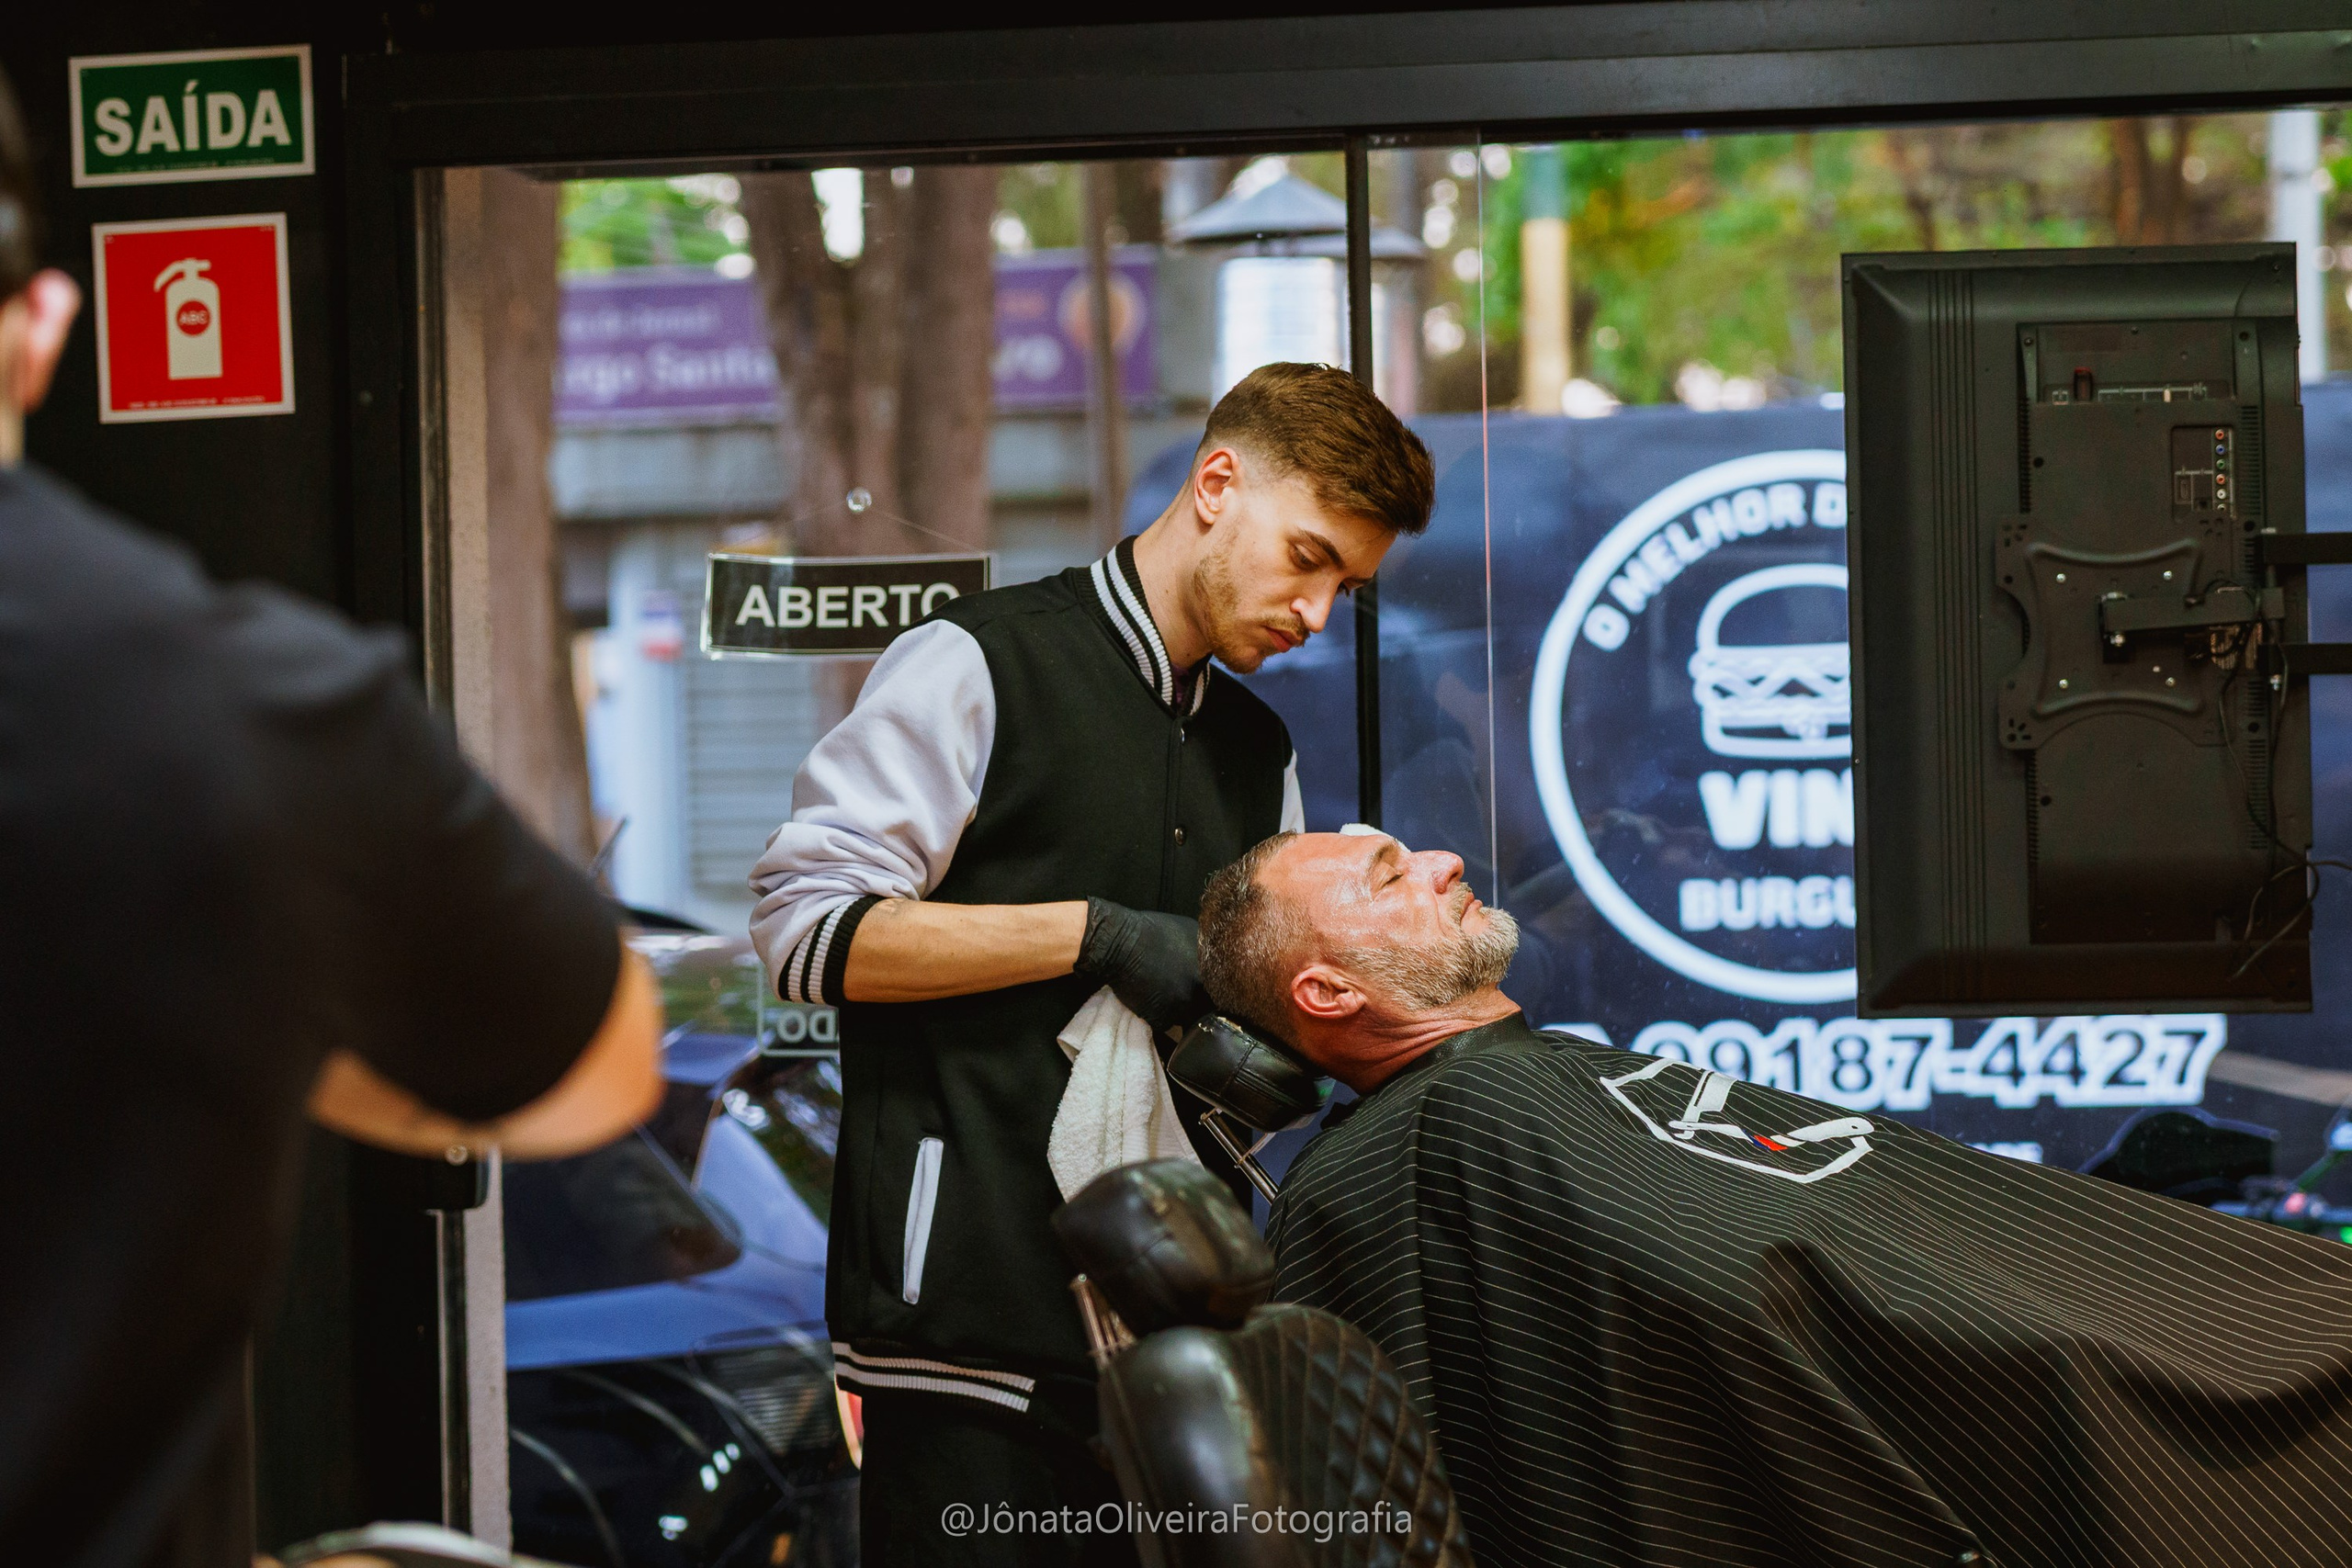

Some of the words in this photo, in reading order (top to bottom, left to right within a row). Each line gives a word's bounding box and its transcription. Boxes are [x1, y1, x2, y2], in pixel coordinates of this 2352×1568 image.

[95, 79, 291, 156] SAÍDA
[1582, 603, 1631, 652] O
[1609, 482, 1807, 615] MELHOR
[1812, 481, 1848, 529] D
